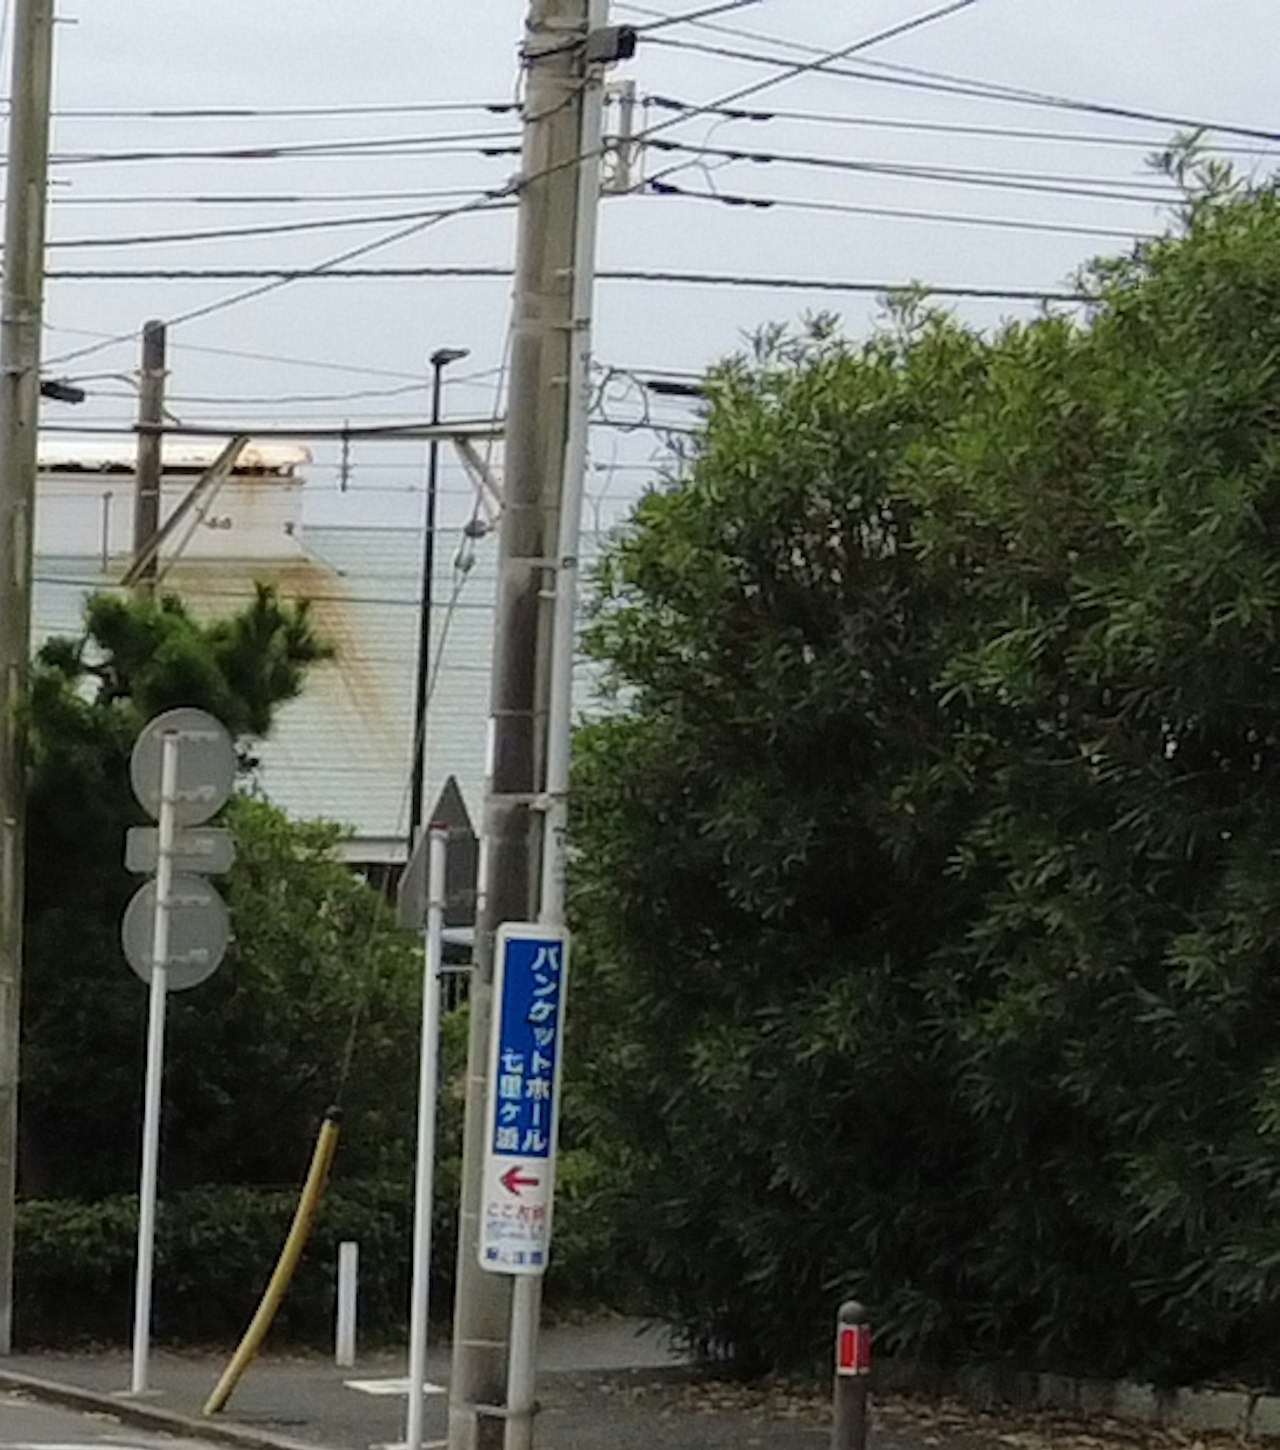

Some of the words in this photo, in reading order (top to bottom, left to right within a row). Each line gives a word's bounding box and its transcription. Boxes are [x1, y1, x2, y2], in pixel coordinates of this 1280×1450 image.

[521, 945, 560, 1153] バンケットホール
